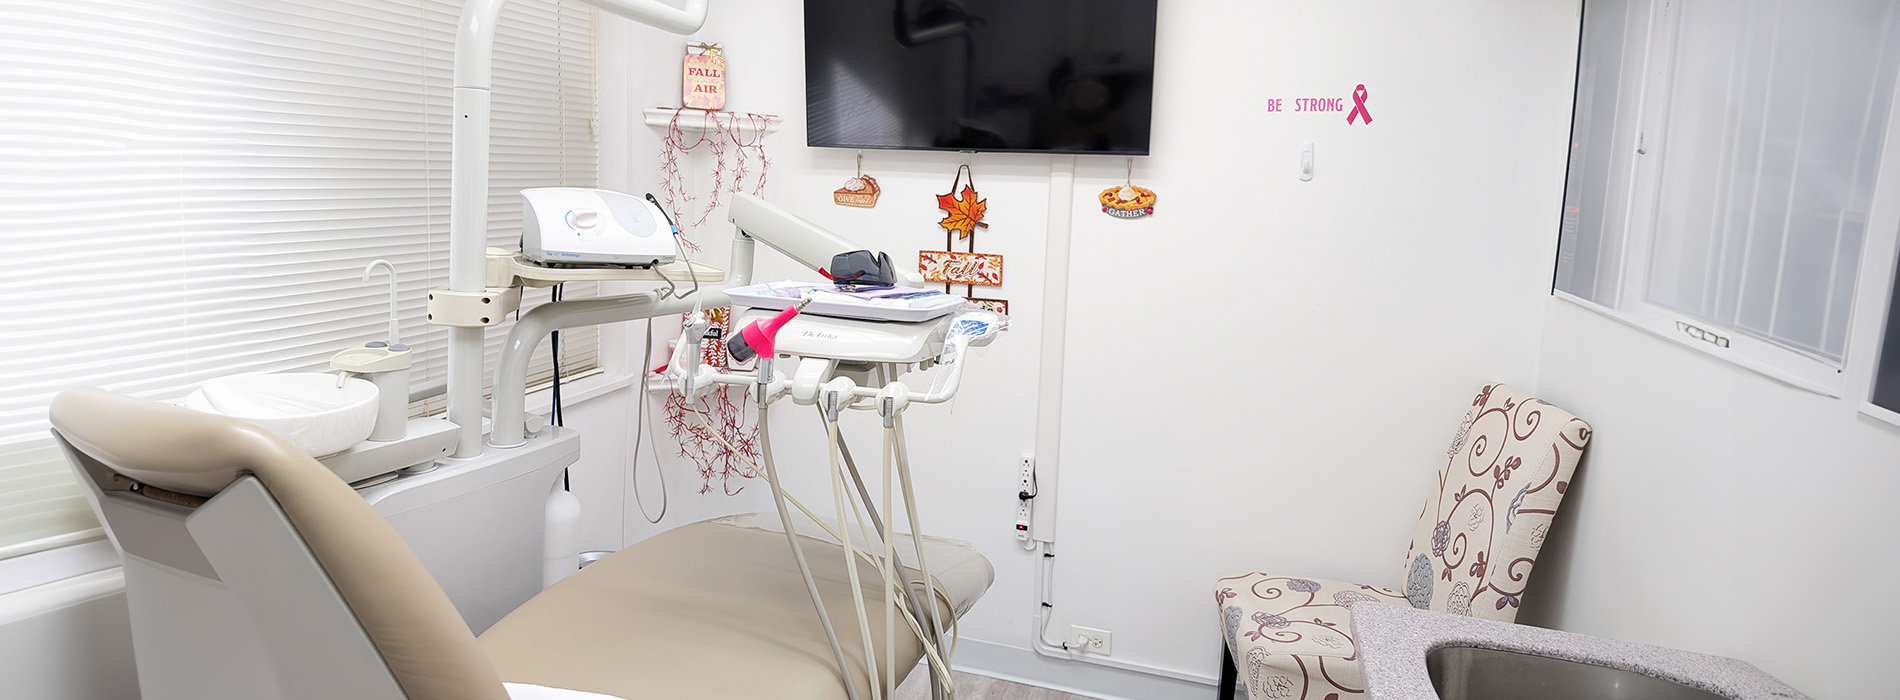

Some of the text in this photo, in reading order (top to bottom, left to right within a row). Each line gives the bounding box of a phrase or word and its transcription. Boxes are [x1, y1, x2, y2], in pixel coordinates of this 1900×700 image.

[688, 67, 721, 78] FALL
[693, 84, 717, 93] AIR
[1267, 97, 1343, 112] BE STRONG
[838, 194, 855, 203] GIVE
[1108, 208, 1146, 217] GATHER
[941, 260, 979, 277] Fall
